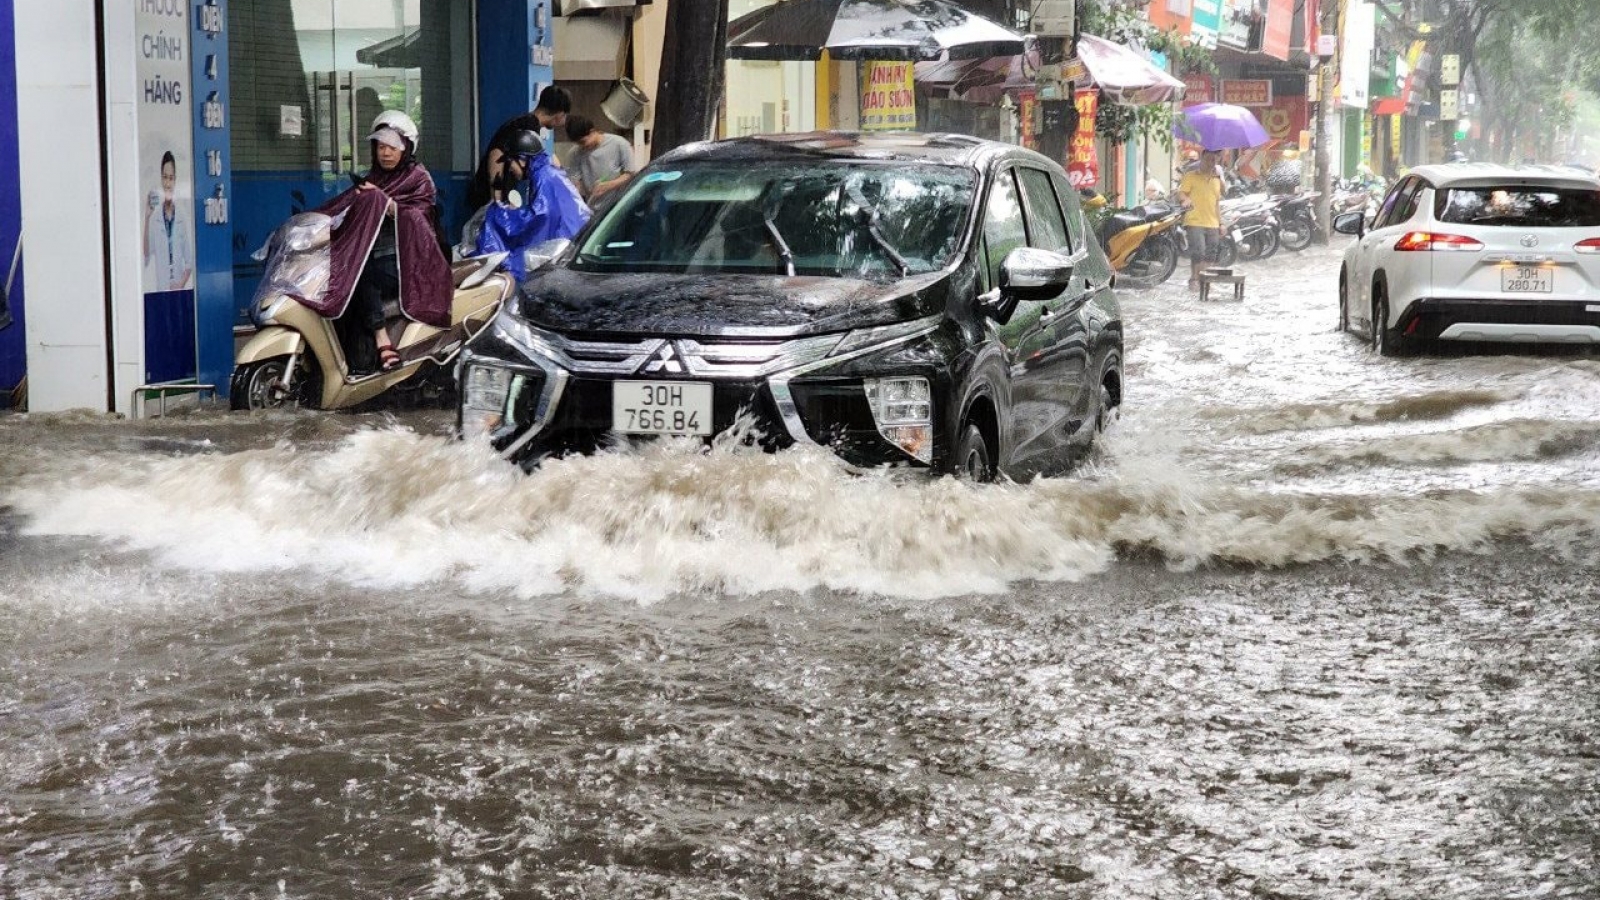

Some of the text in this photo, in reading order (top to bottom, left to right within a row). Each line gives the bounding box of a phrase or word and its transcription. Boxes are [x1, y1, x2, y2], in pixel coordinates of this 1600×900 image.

[142, 30, 182, 61] CHÍNH
[144, 75, 182, 105] HÃNG
[1508, 280, 1546, 291] 280.71
[1516, 269, 1538, 280] 30H
[641, 385, 682, 406] 30H
[624, 408, 700, 431] 766.84
